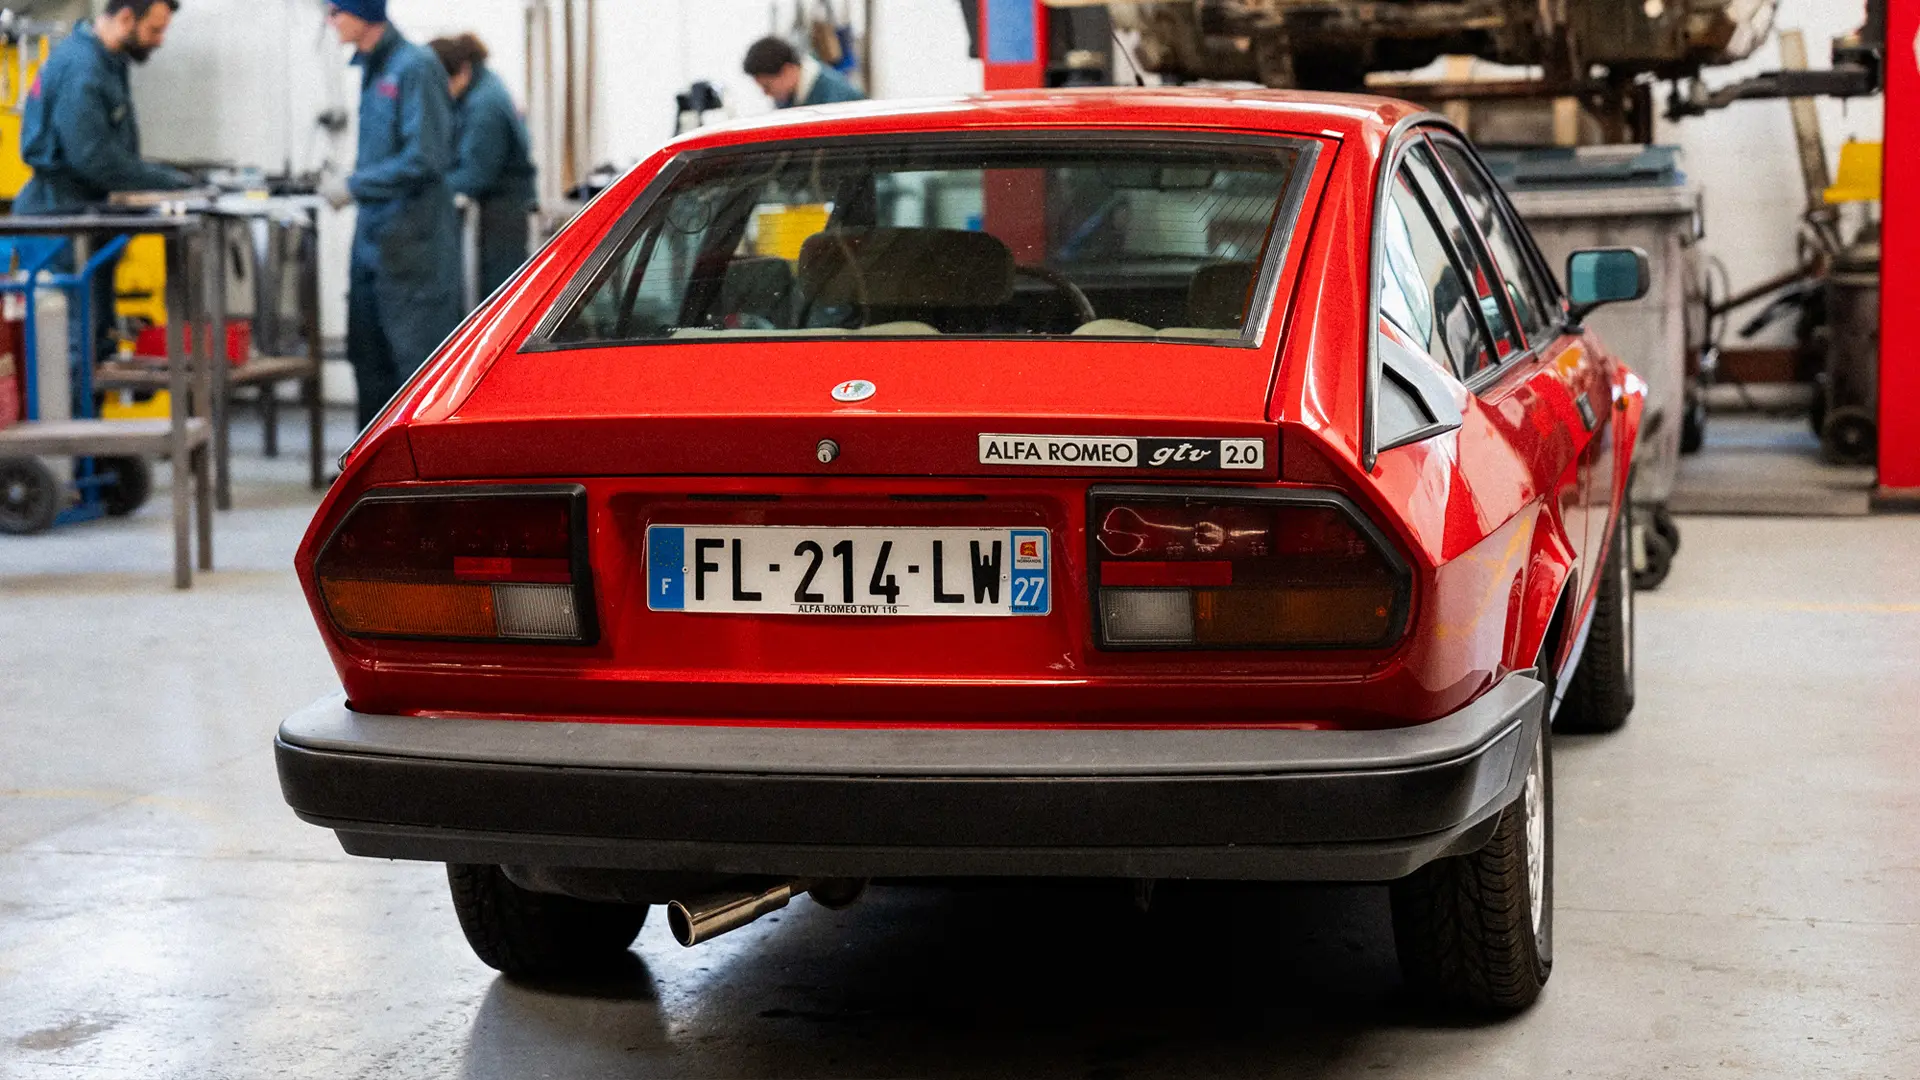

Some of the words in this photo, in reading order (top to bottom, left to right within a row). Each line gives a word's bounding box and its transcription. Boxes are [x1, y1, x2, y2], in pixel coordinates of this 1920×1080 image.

[985, 441, 1042, 461] ALFA
[1049, 442, 1133, 463] ROMEO
[1148, 442, 1211, 466] gtv
[1225, 445, 1258, 465] 2.0
[695, 538, 1002, 604] FL-214-LW
[662, 578, 672, 595] F
[1014, 577, 1045, 606] 27
[797, 604, 821, 614] ALFA
[824, 604, 857, 614] ROMEO
[860, 605, 879, 614] GTV
[882, 605, 898, 614] 116
